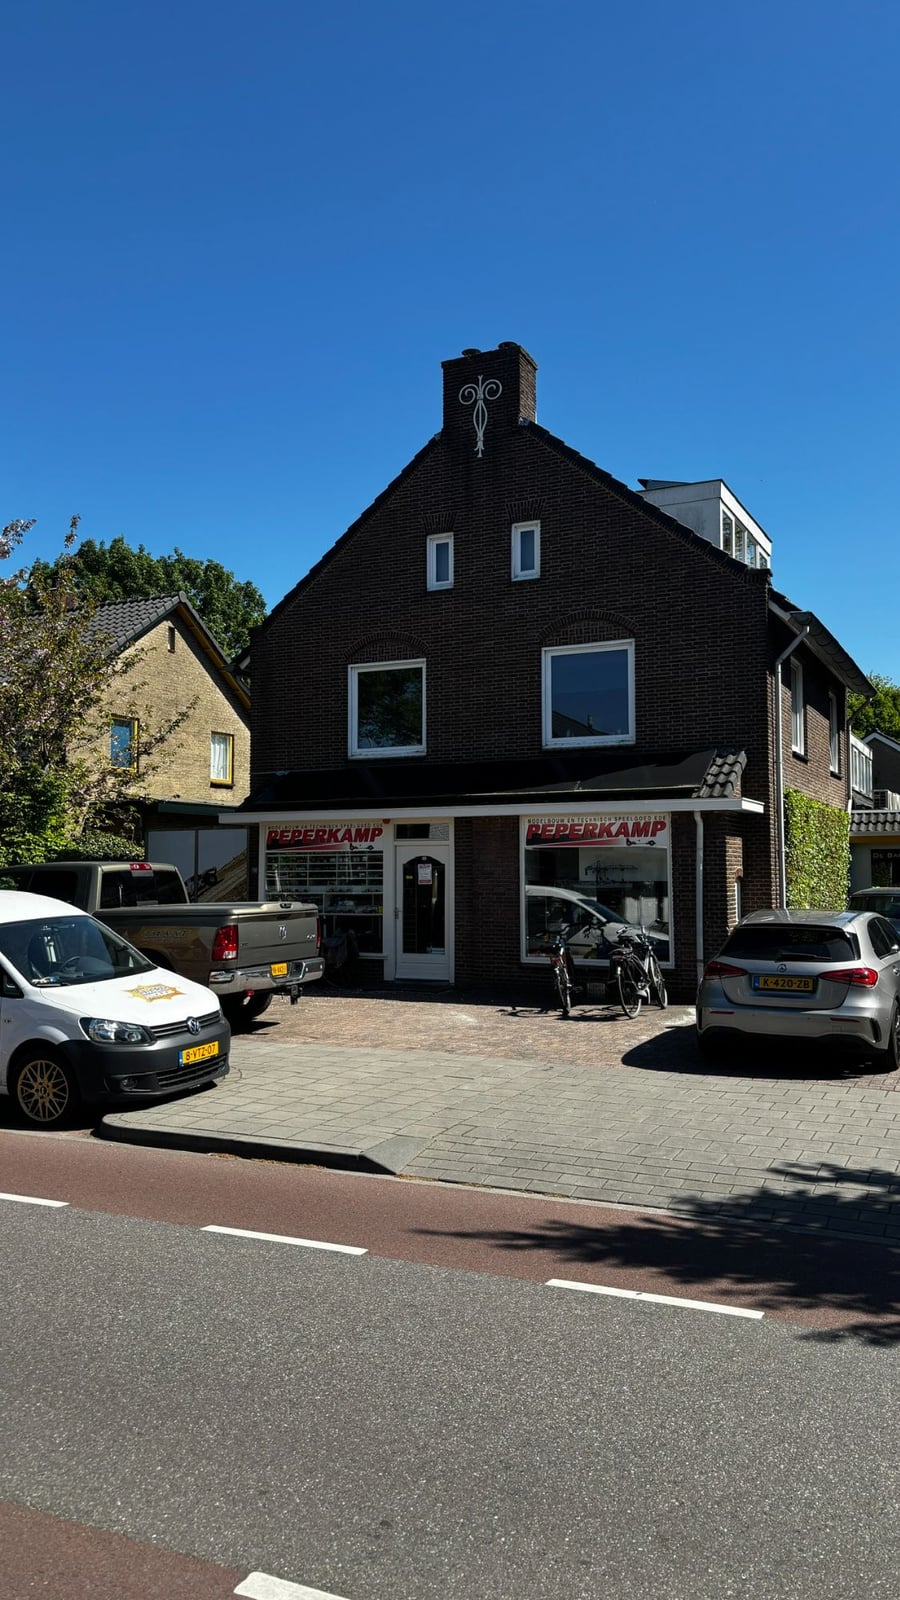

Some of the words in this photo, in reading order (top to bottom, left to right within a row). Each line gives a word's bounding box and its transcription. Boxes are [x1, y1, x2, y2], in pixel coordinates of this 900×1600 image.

[267, 828, 384, 844] PEPERKAMP
[526, 821, 667, 839] PEPERKAMP
[763, 978, 810, 989] K-420-ZB
[185, 1044, 216, 1061] 8-VTZ-07
